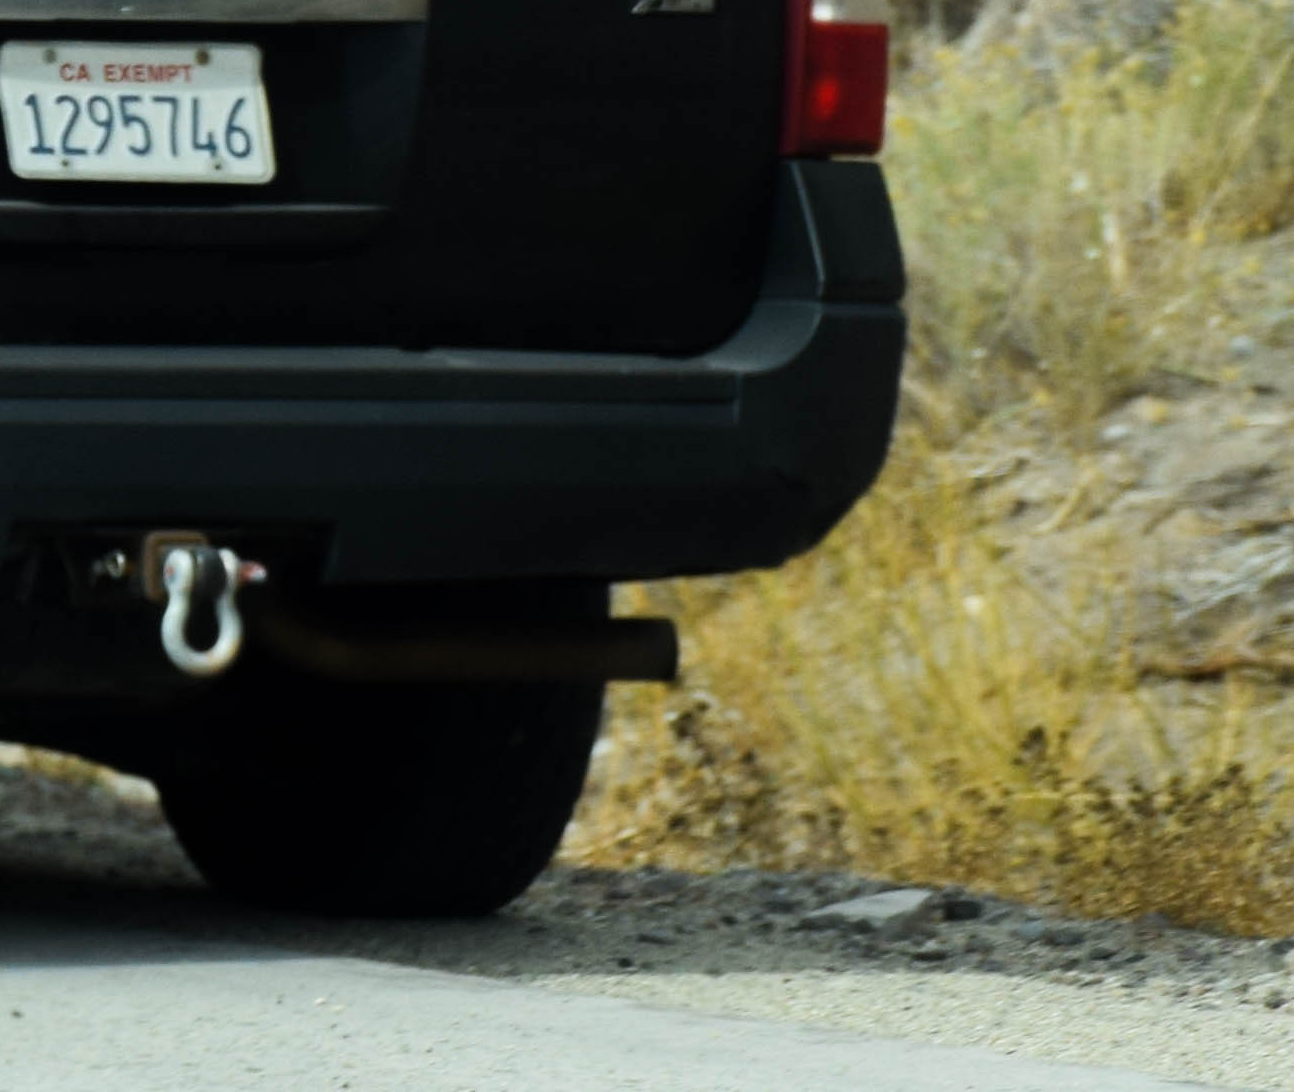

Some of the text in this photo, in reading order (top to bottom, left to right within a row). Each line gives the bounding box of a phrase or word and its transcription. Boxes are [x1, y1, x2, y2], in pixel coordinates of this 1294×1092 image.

[59, 62, 194, 83] CA EXEMPT
[24, 93, 253, 159] 1295746
